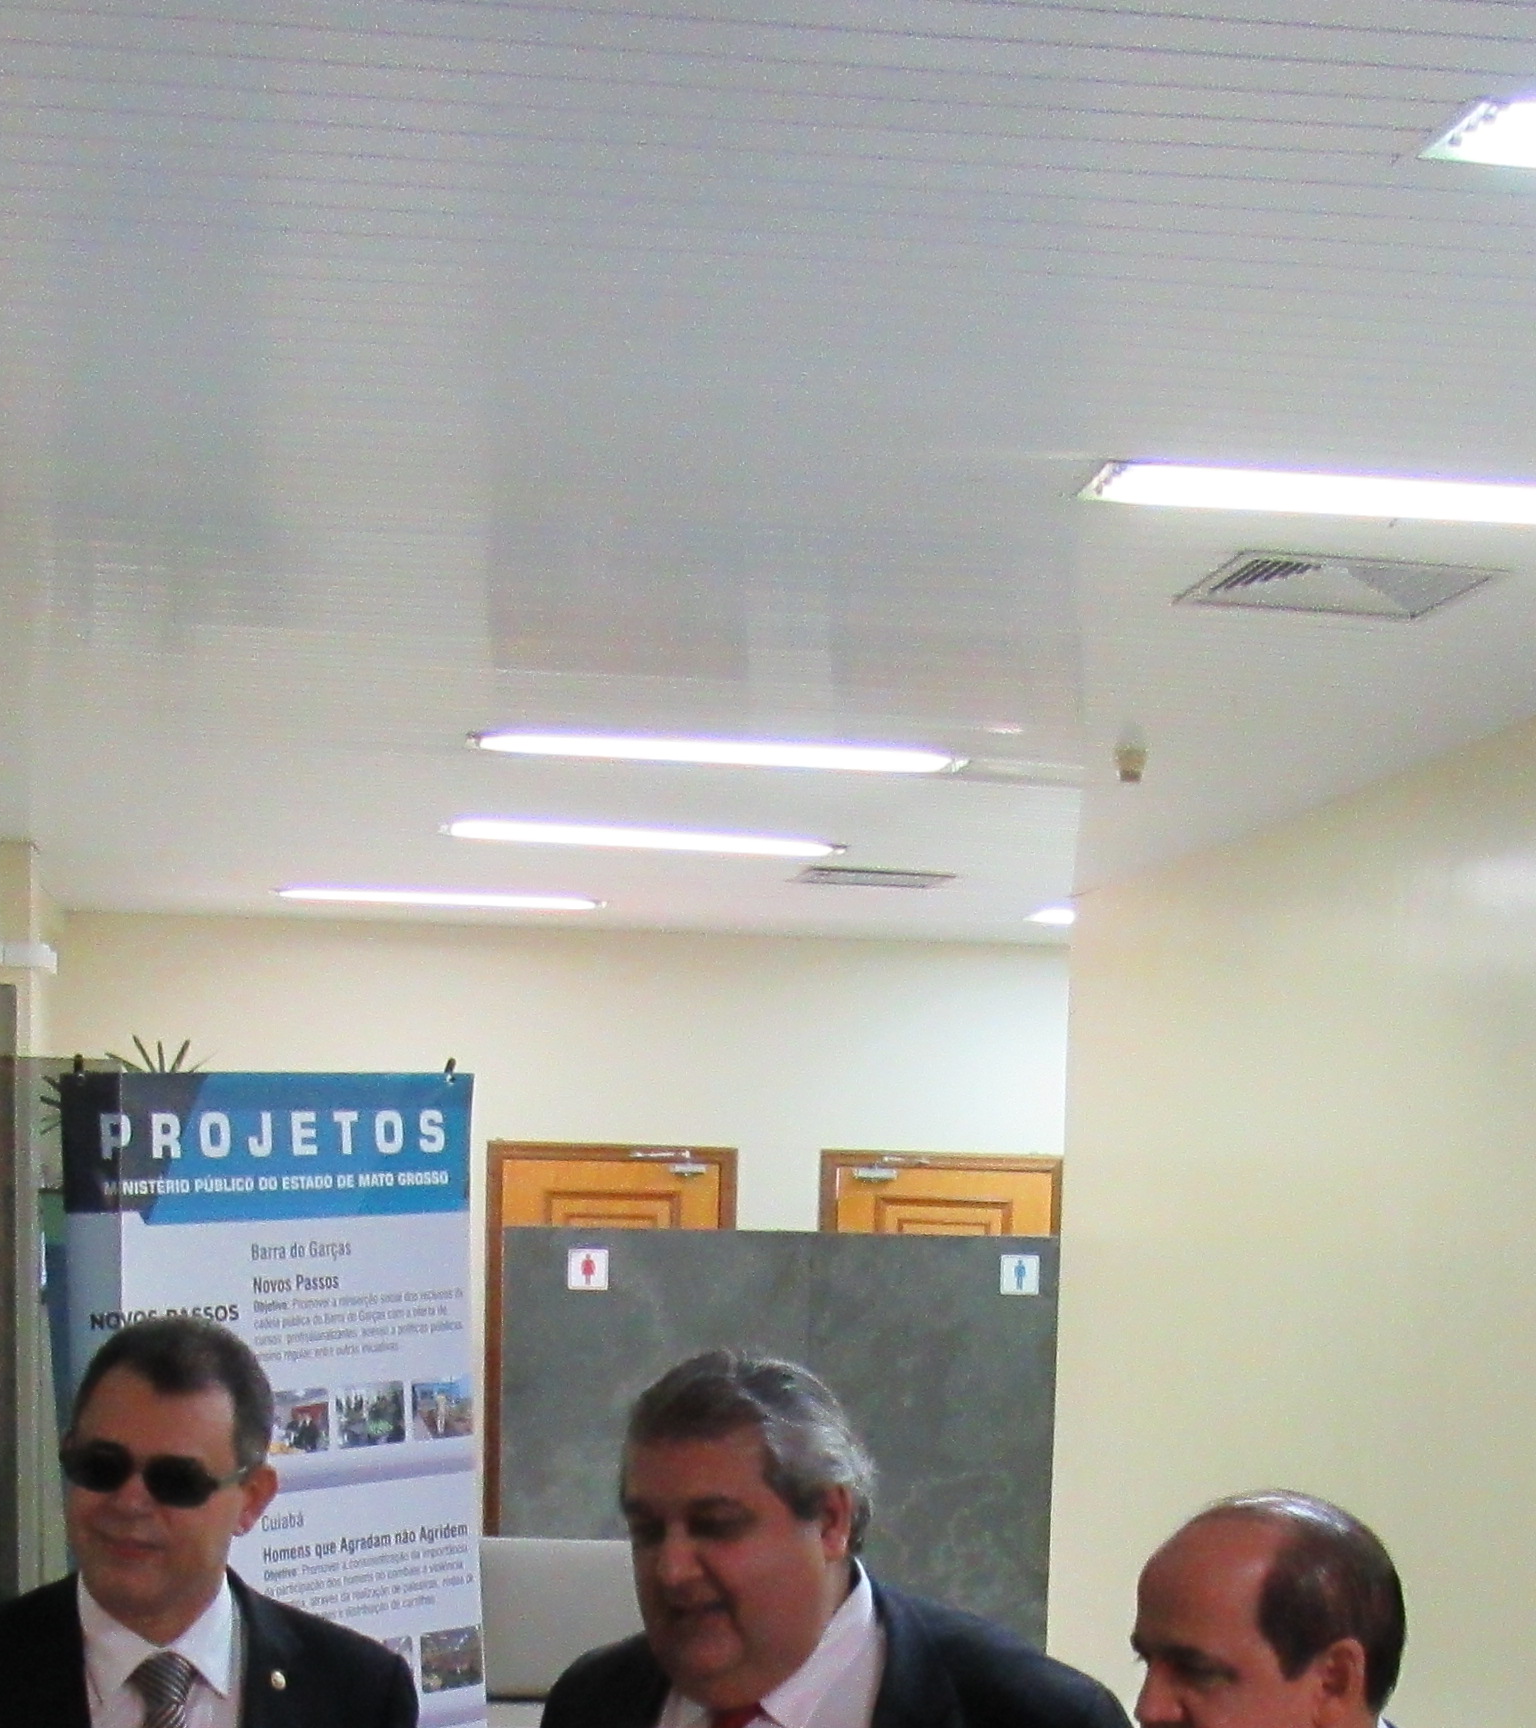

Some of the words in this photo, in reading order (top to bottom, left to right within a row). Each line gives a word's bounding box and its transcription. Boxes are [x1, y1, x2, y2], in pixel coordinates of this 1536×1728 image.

[99, 1109, 446, 1160] PROJETOS
[104, 1175, 190, 1196] MNISTÉRIO
[195, 1173, 254, 1193] PÚBLICO
[259, 1175, 278, 1191] DO
[283, 1174, 333, 1191] ESTADO
[337, 1173, 355, 1188] DE
[359, 1172, 394, 1187] MATO
[398, 1170, 449, 1186] GROSSO
[251, 1242, 286, 1261] Barra
[309, 1240, 352, 1261] Garças
[253, 1276, 292, 1294] Novos
[296, 1274, 339, 1291] Passos
[262, 1513, 304, 1532] Cuiabá
[263, 1543, 311, 1564] Homens
[315, 1540, 336, 1558] que
[340, 1533, 391, 1554] Agradam
[394, 1529, 416, 1545] não
[420, 1523, 468, 1543] Agridem
